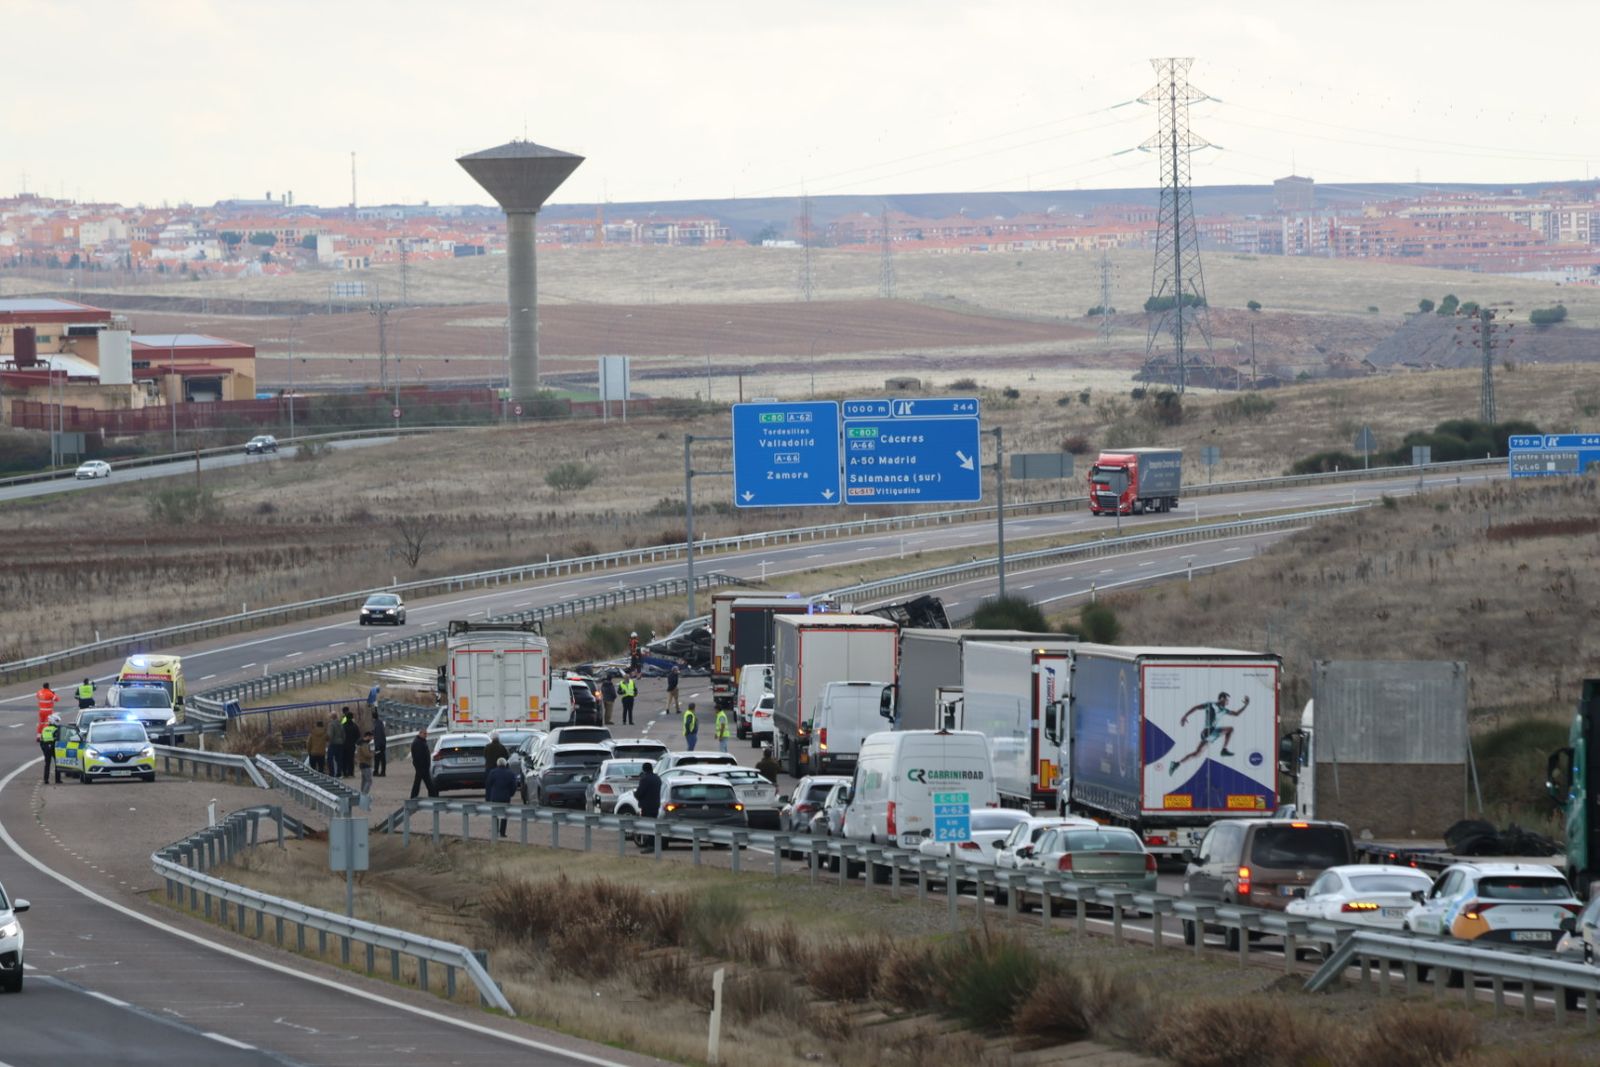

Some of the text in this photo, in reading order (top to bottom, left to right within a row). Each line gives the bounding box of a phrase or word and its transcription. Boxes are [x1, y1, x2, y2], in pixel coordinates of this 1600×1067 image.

[847, 405, 886, 413] 1000 m
[953, 403, 974, 411] 244
[761, 413, 809, 422] E-80 A-62
[763, 428, 810, 436] Tordesillas
[759, 438, 815, 448] Valladolid
[852, 441, 874, 449] A-66
[776, 455, 798, 463] A-66
[850, 455, 916, 465] A-50 Madrid
[767, 471, 809, 480] Zamora
[850, 472, 941, 483] Salamanca (sur)
[876, 487, 921, 496] Vitigudino
[940, 794, 964, 802] E-80
[941, 806, 964, 814] A-62
[939, 827, 966, 839] 246
